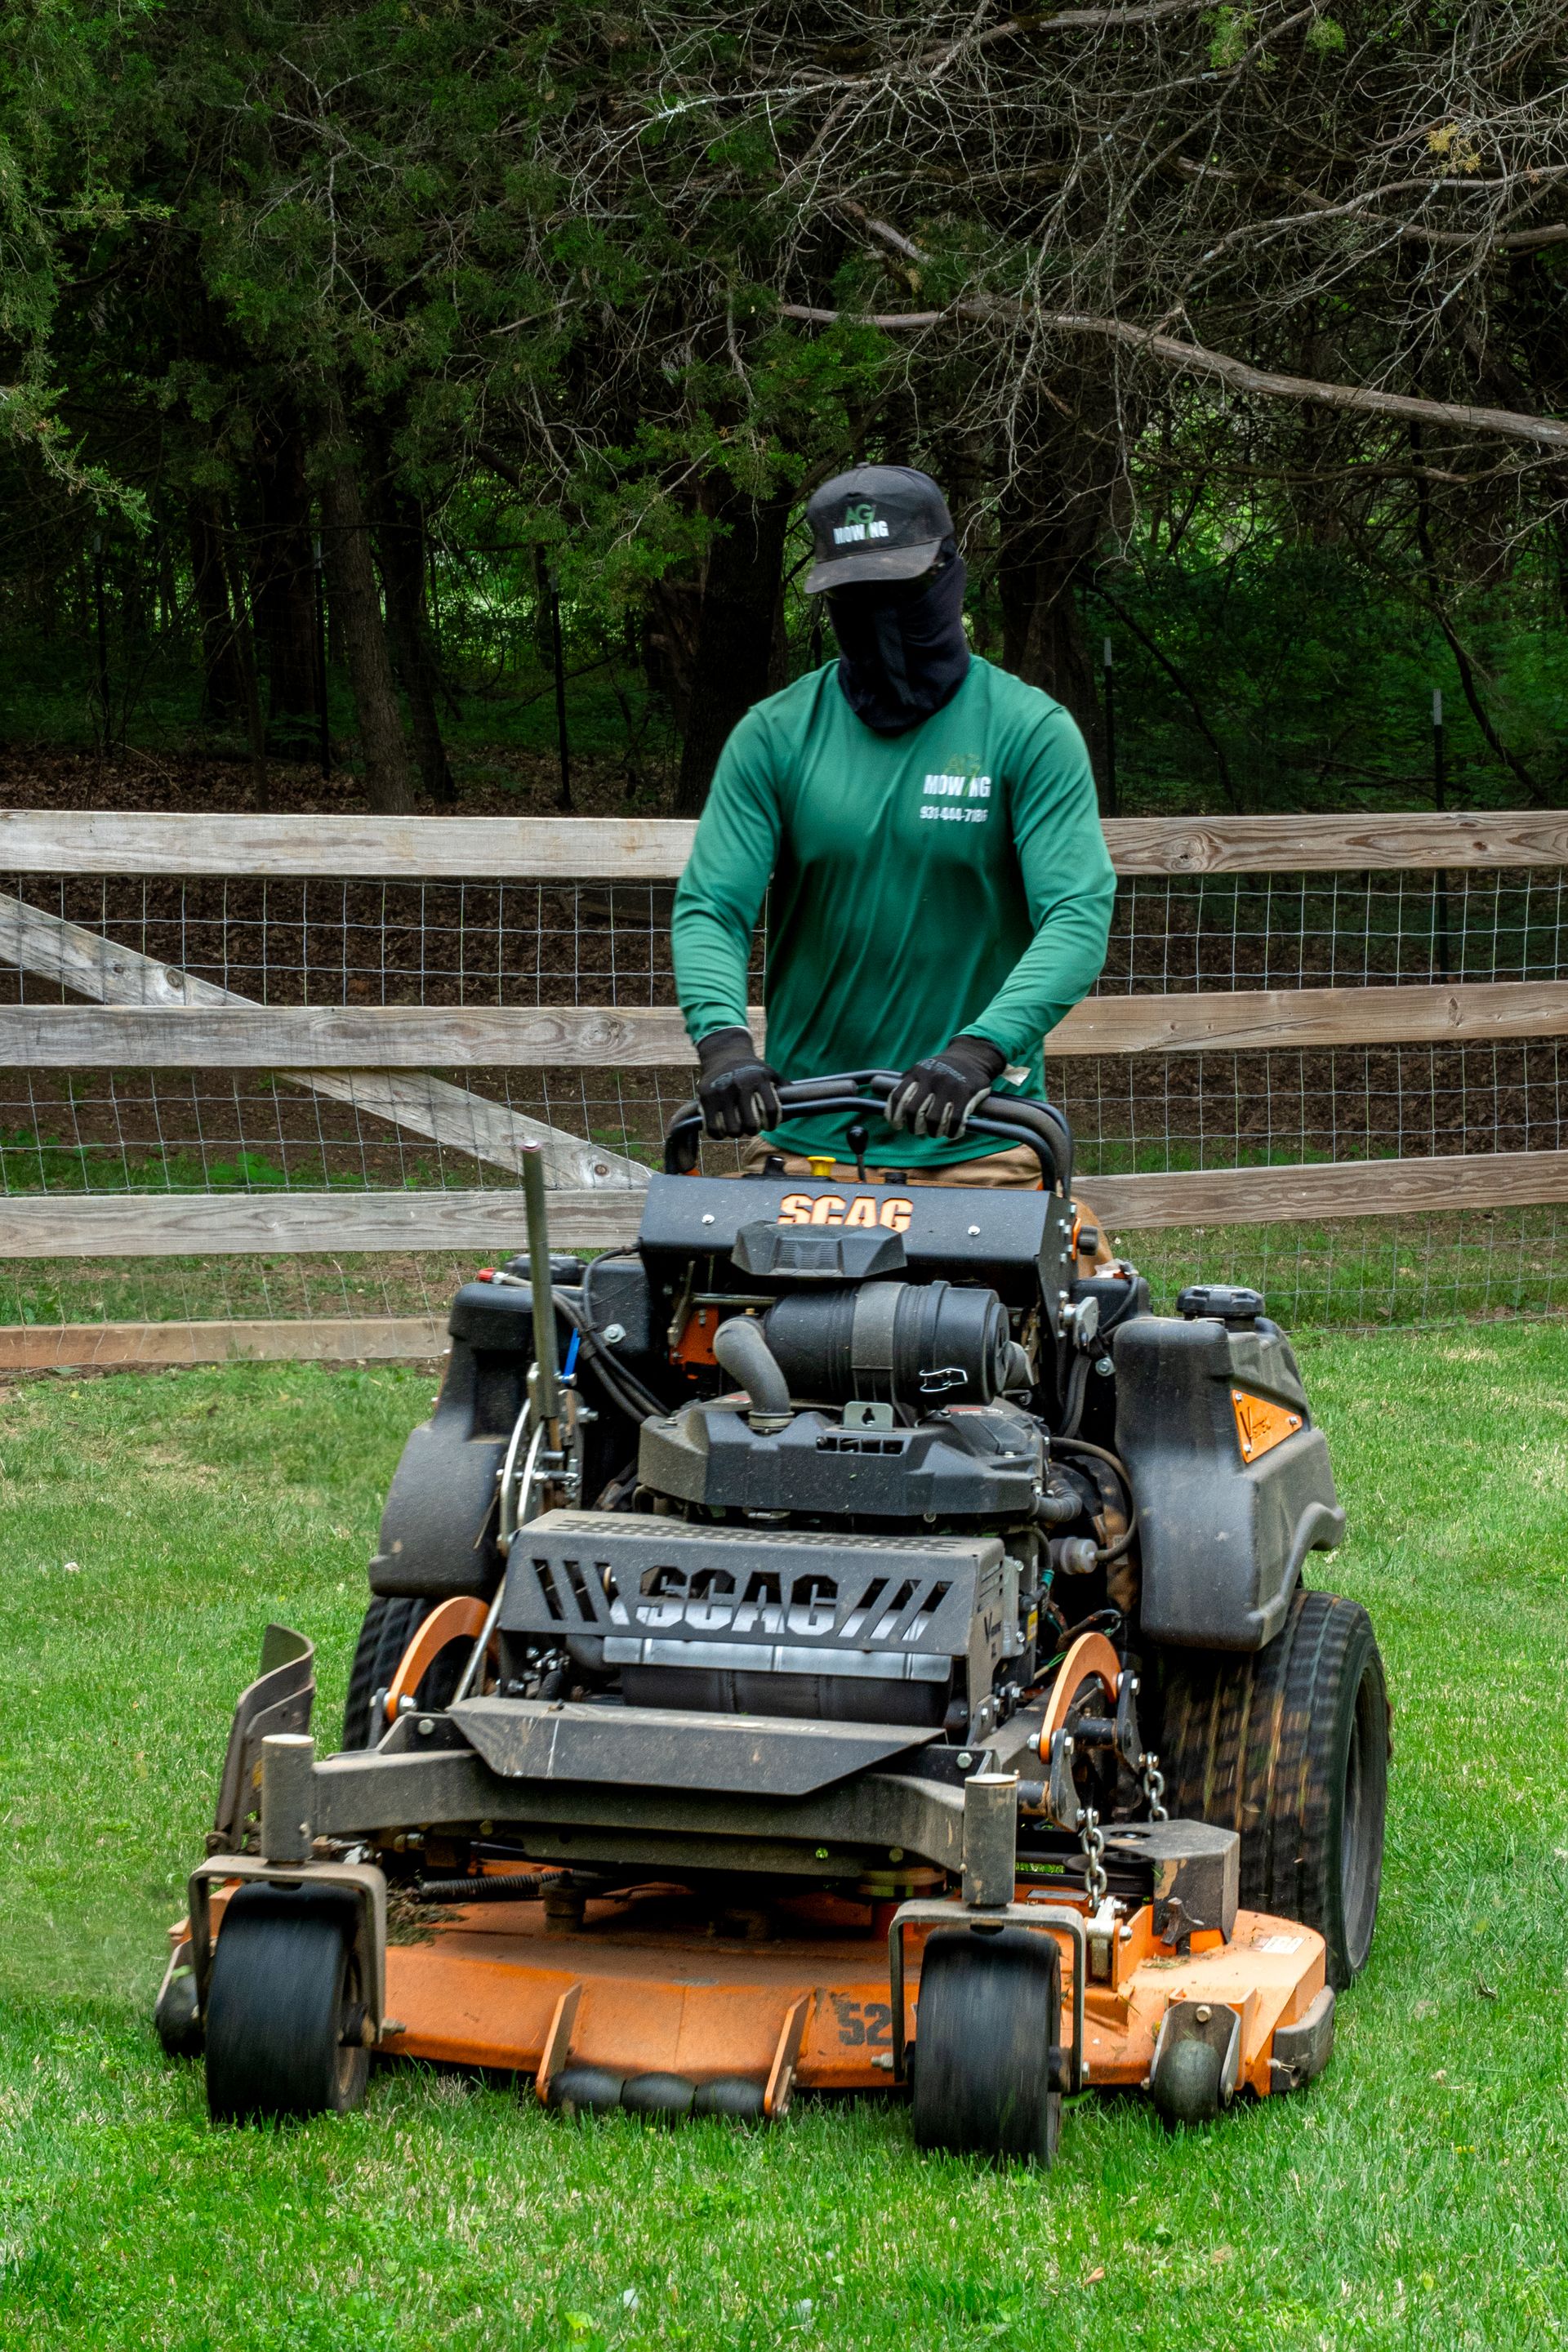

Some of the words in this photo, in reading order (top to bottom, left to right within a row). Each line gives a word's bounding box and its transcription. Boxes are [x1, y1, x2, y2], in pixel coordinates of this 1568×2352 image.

[777, 1193, 914, 1233] SCAG
[635, 1565, 839, 1637] SCAG
[837, 2002, 893, 2047] 52
